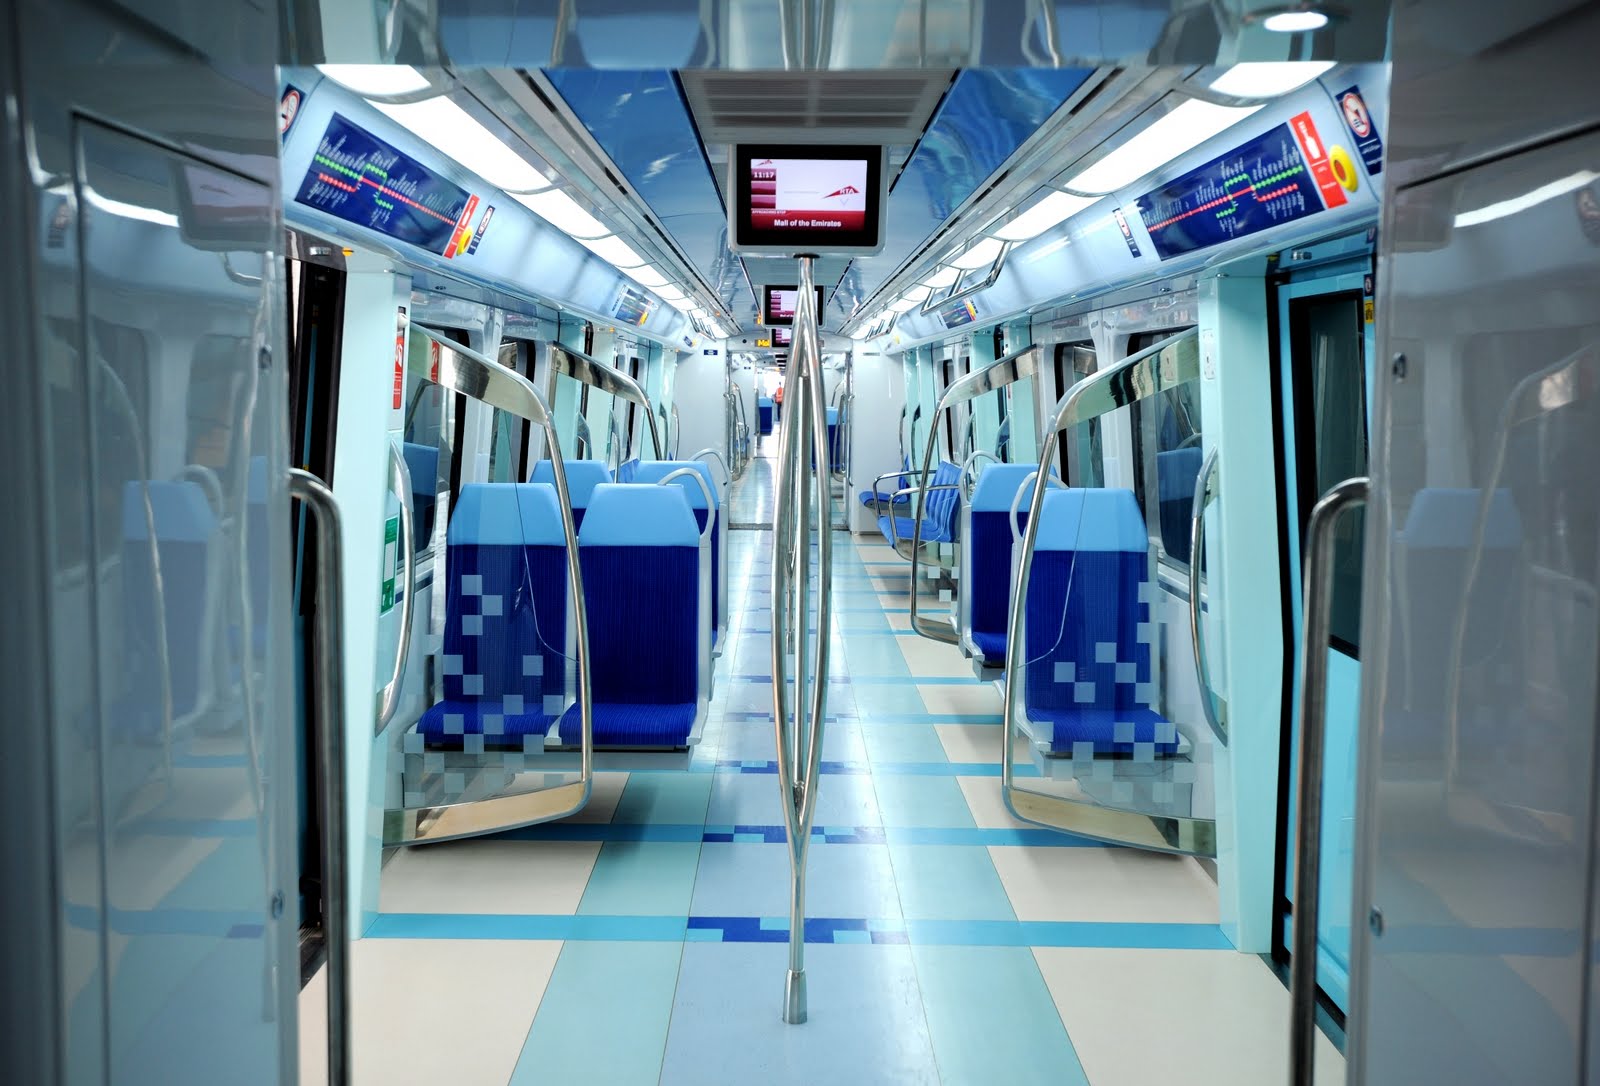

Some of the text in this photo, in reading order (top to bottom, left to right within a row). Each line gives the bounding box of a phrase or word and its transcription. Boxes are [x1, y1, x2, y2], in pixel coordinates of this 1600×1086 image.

[774, 219, 842, 227] Mall of the Emirates
